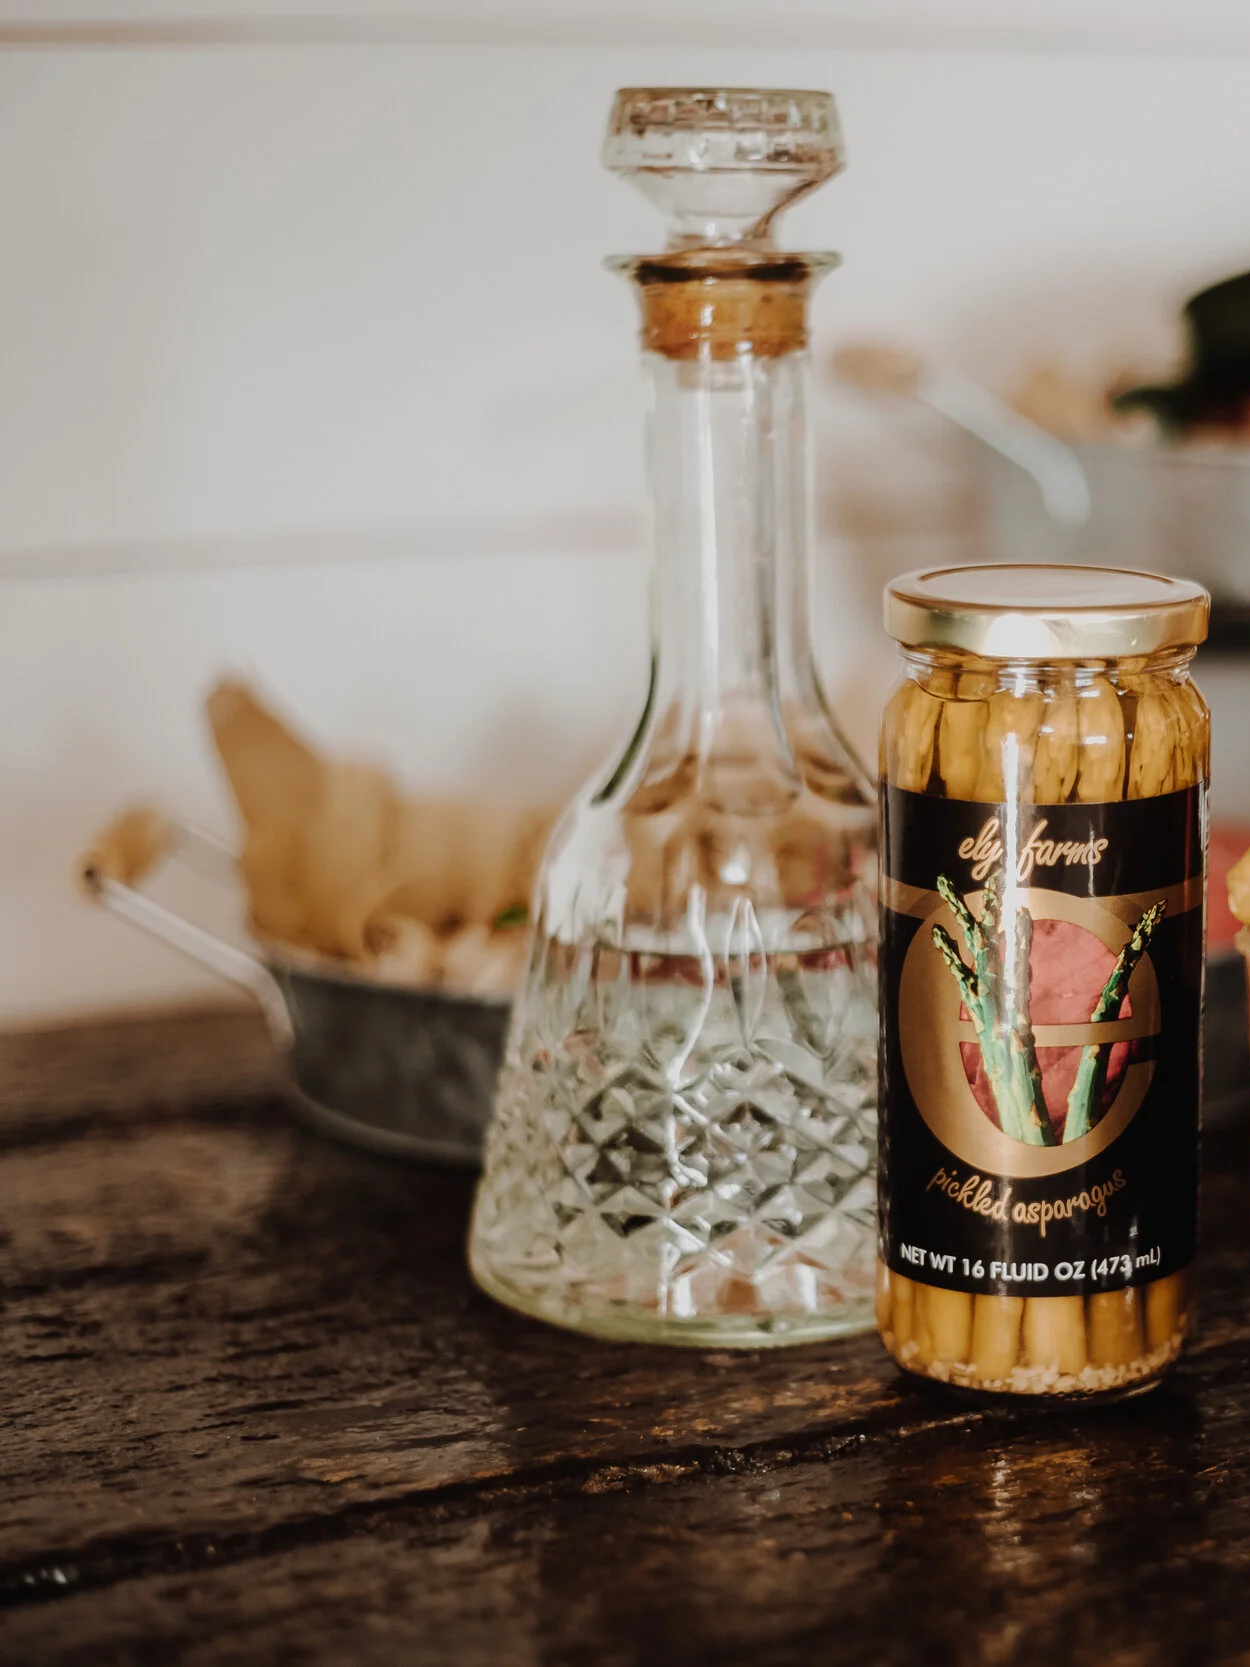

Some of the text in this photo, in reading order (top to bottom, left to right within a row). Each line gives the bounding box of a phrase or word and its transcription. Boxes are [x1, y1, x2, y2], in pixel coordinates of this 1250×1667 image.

[958, 815, 1109, 882] ely farms
[925, 1167, 1127, 1238] pickled asparagus
[901, 1242, 1162, 1282] NET WT 16 FLUID OZ (473 mL)
